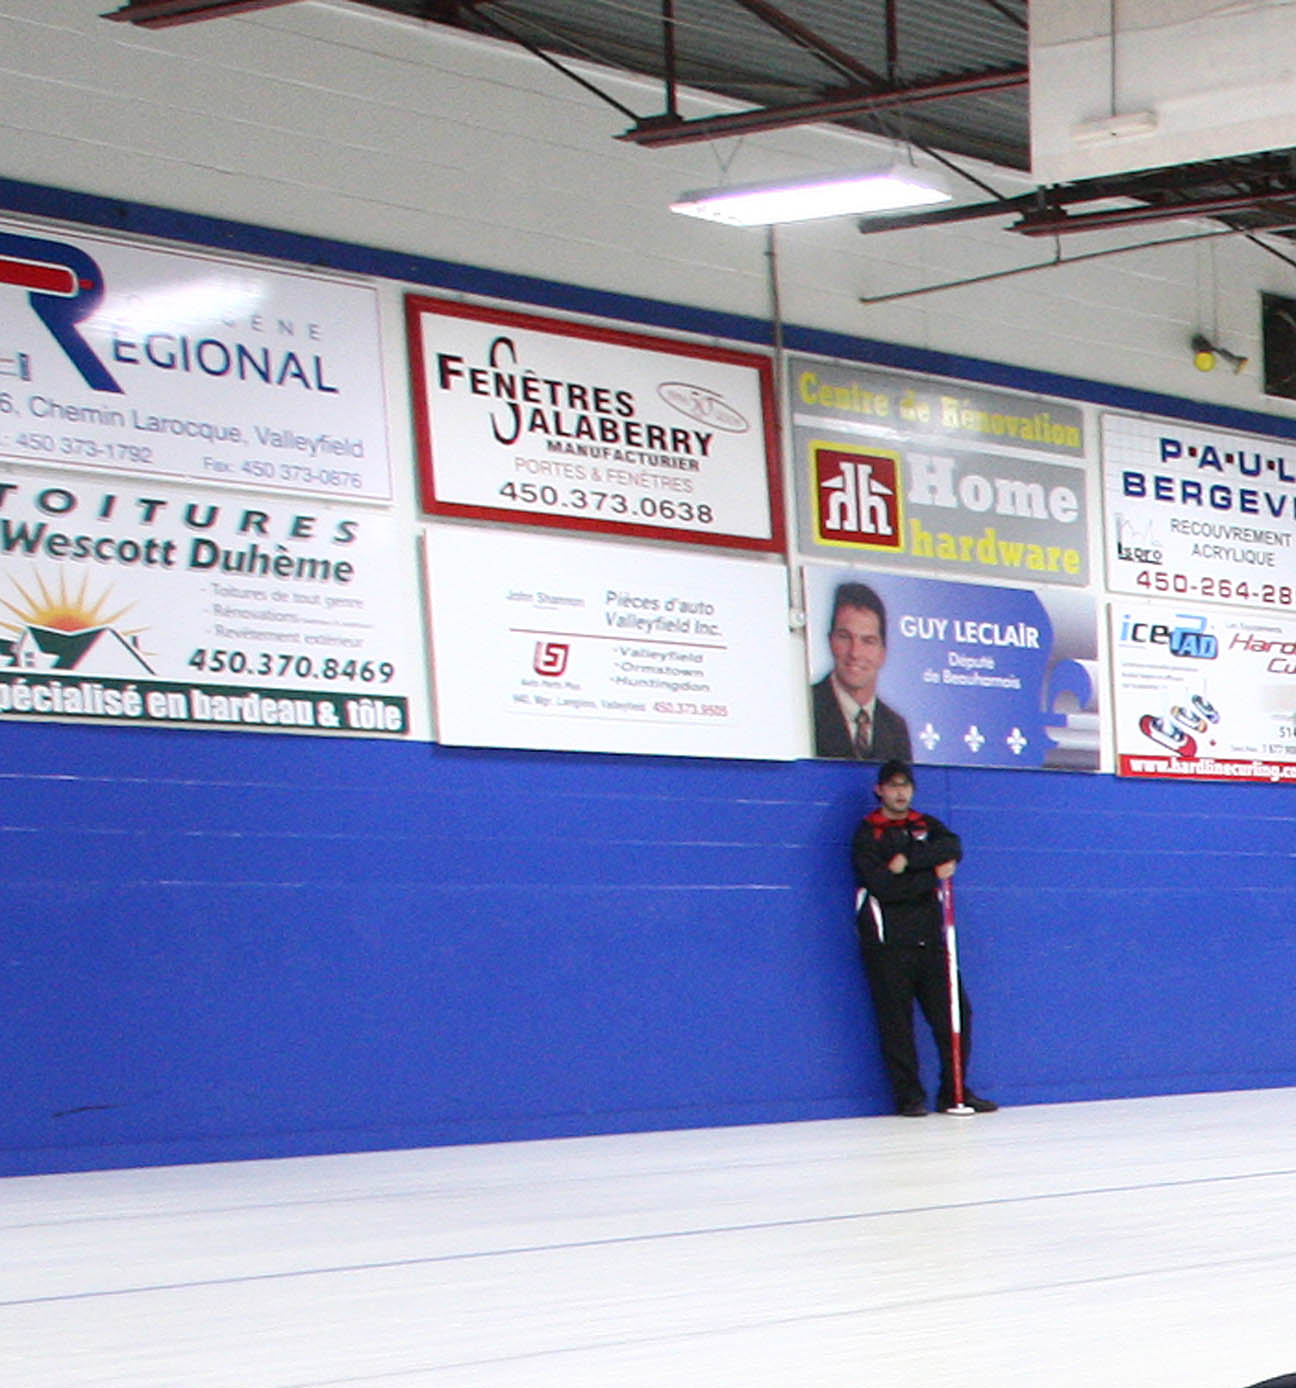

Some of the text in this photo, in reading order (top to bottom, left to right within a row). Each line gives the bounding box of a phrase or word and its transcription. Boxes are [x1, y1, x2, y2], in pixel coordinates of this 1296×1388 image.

[436, 351, 636, 418] FENÊTRES
[28, 395, 126, 429] Chemin
[254, 424, 365, 459] Valleyfield
[799, 371, 1082, 448] Centre de Rénovation
[16, 431, 55, 452] 450
[242, 459, 275, 480] 450
[515, 457, 586, 481] PORTES
[590, 470, 600, 483] &
[547, 439, 700, 472] MANUFACTURIER
[500, 481, 714, 525] 450.373.0638
[906, 453, 1080, 523] Home
[0, 518, 355, 583] Wescott Duhème
[911, 518, 1082, 574] hardware
[1170, 518, 1292, 547] RECOUVREMENT
[1191, 544, 1277, 567] ACRYLIQUE
[605, 590, 660, 611] Pièces
[605, 612, 692, 634] Valleyfield
[901, 615, 949, 640] GUY
[188, 648, 395, 685] 450.370.8469
[922, 668, 941, 684] de
[948, 652, 996, 670] Député
[147, 690, 190, 720] en
[191, 690, 316, 727] bardeau
[318, 703, 341, 729] &
[348, 697, 404, 732] tôle
